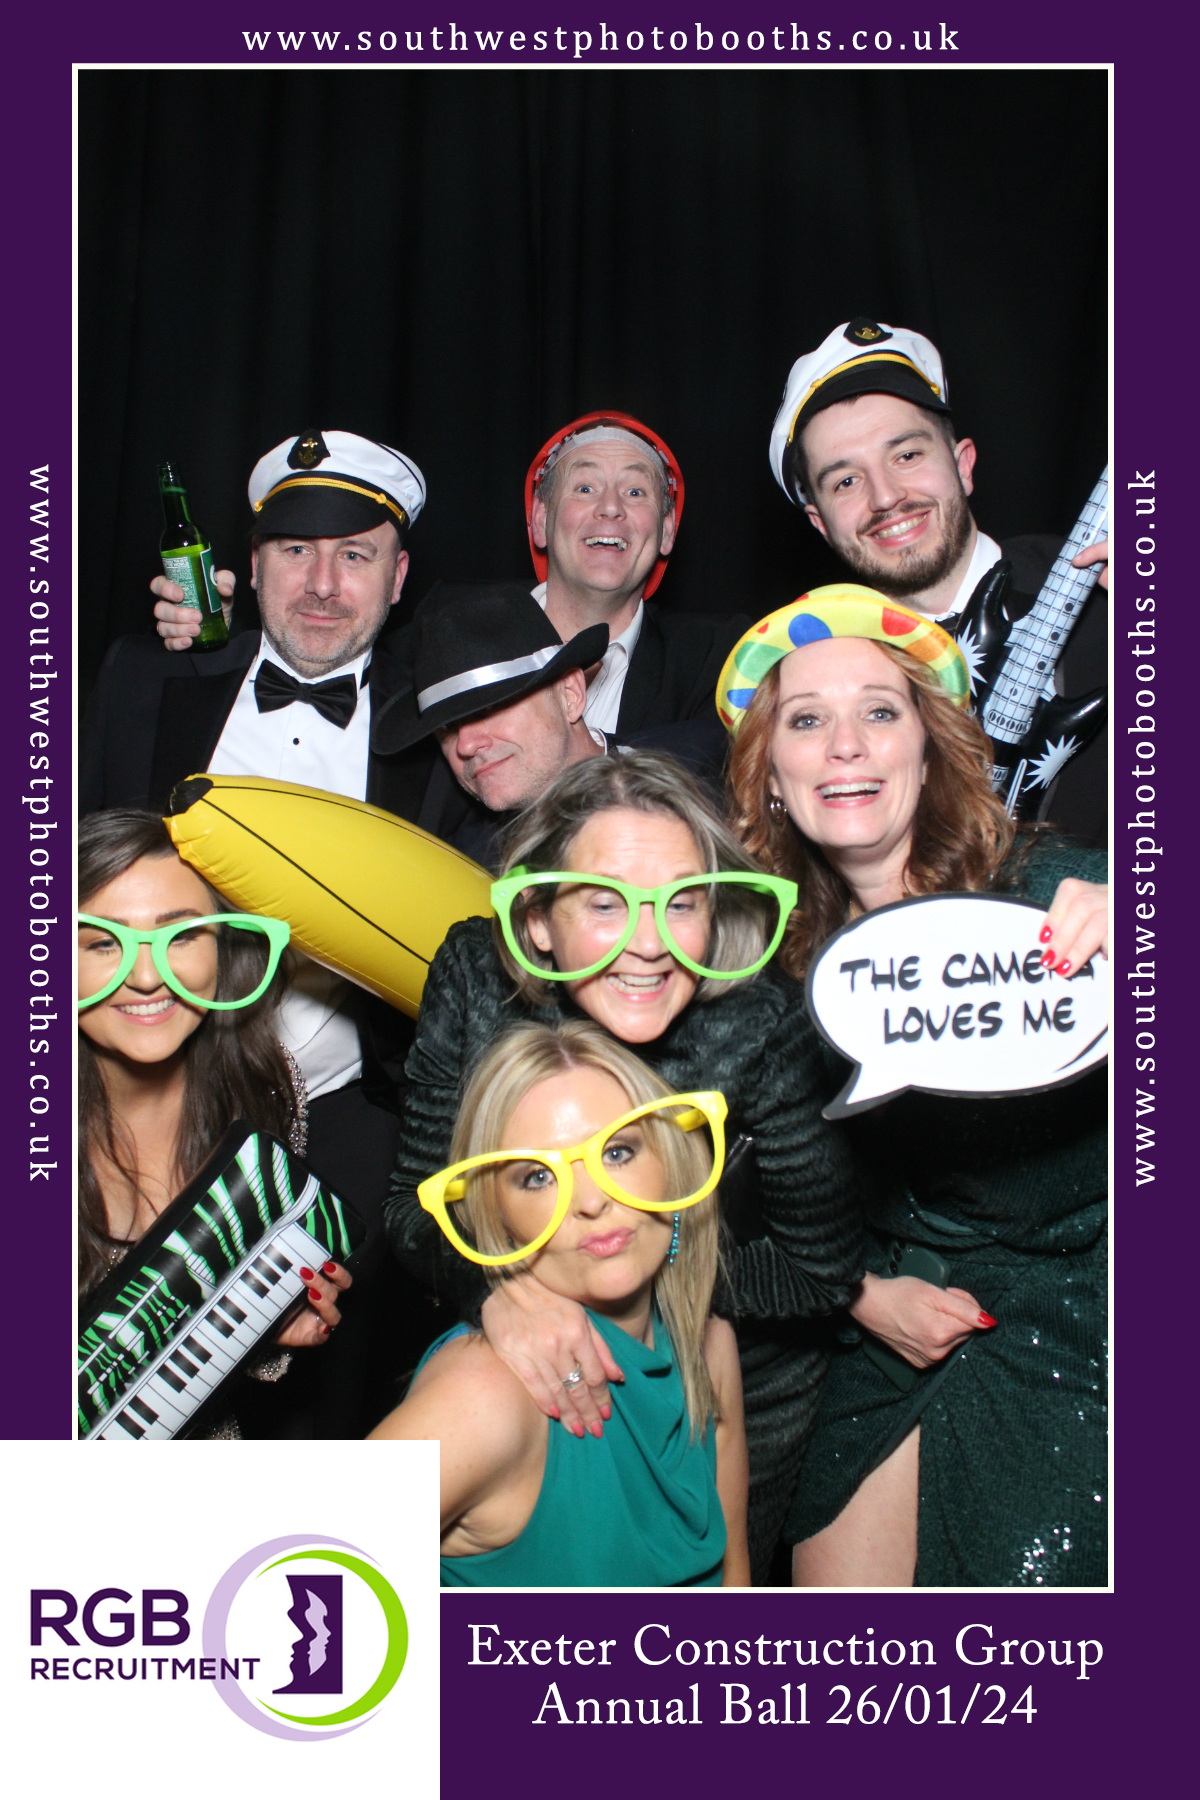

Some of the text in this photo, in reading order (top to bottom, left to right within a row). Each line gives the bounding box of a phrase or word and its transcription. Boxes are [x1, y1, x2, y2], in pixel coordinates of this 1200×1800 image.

[840, 949, 1094, 993] THE CAMEA
[884, 997, 1076, 1044] LOVES ME
